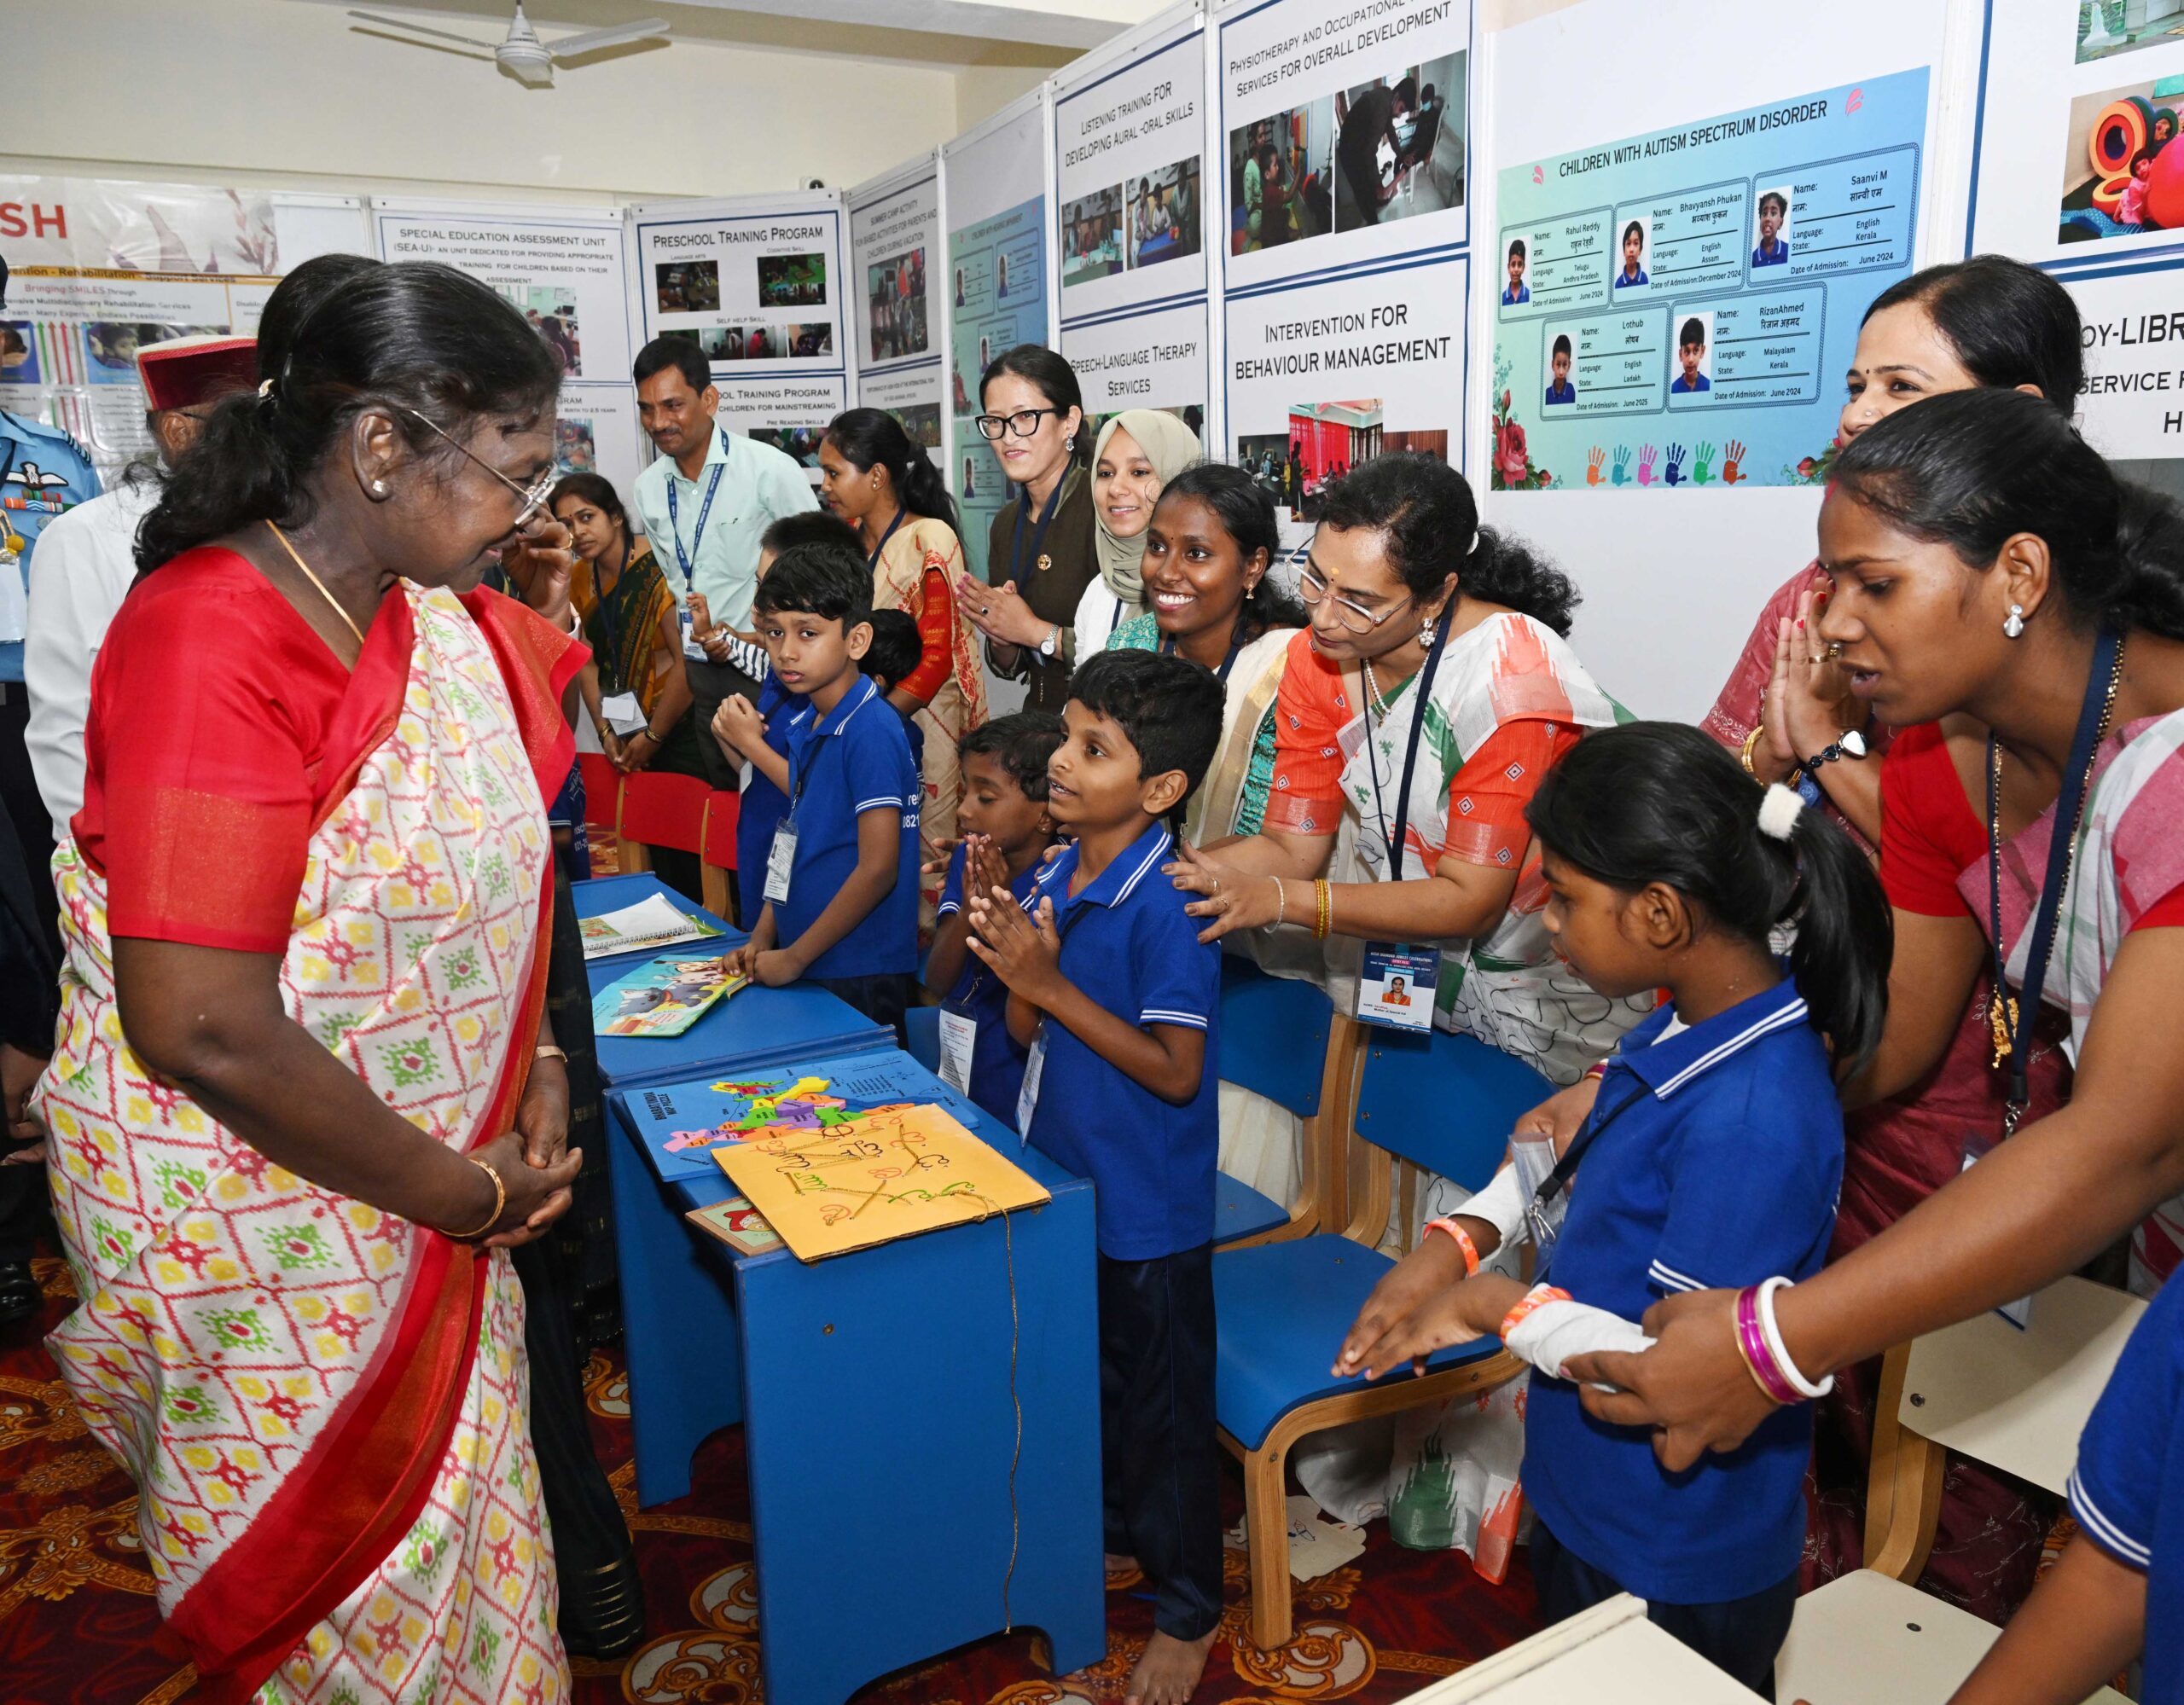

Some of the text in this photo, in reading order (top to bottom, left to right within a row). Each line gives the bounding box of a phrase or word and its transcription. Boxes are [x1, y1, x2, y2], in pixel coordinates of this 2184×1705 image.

[1230, 36, 1299, 75] PHYSIOTHERAPY
[1303, 27, 1321, 45] AND
[1237, 2, 1450, 97] SERVICES FOR OVERALL DEVELOPMENT
[1082, 81, 1171, 135] LISTENING TRAINING FOR
[1066, 136, 1111, 166] DEVELOPING
[1113, 128, 1137, 147] AURAL
[1165, 102, 1193, 125] SKILLS
[1560, 100, 1827, 177] CHILDREN WITH AUTISM SPECTRUM DISORDER
[1794, 171, 1887, 194] Name: Saanvi M
[1653, 194, 1741, 217] Name: Bhavyansh Phukan
[0, 202, 67, 239] SH
[1566, 225, 1581, 235] Rahul
[1583, 222, 1600, 232] Reddy
[1793, 217, 1879, 239] Language: English
[400, 229, 445, 239] SPECIAL
[449, 231, 509, 241] EDUCATION
[514, 235, 579, 245] ASSESSMENT
[653, 227, 822, 248] PRESCHOOL TRAINING PROGRAM
[1792, 231, 1877, 251] State: Kerala
[1653, 242, 1721, 258] Language: English
[1702, 255, 1719, 264] Assam
[1791, 252, 1893, 274] Date of Admission: June 2024
[59, 268, 135, 279] Rehabilitation
[1533, 264, 1589, 276] Language: Telugu
[1581, 272, 1599, 281] Pradesh
[25, 284, 66, 293] Bringing
[1651, 281, 1662, 290] Date
[1728, 270, 1741, 278] 2024
[1549, 296, 1572, 304] Admission:
[1579, 292, 1590, 300] June
[1266, 304, 1408, 343] INTERVENTION FOR
[1717, 310, 1739, 319] Name:
[1582, 328, 1599, 336] Name:
[1071, 342, 1197, 374] SPEECH-LANGUAGE THERAPY
[1236, 336, 1450, 380] BEHAVIOUR MANAGEMENT
[1719, 346, 1795, 360] Language: Malayalam
[1579, 360, 1641, 374] Language: English
[1770, 361, 1788, 369] Kerala
[1108, 379, 1150, 396] SERVICES
[2076, 372, 2171, 394] SERVICE
[737, 390, 781, 398] TRAINING
[785, 389, 830, 397] PROGRAM
[1736, 388, 1766, 398] Admission:
